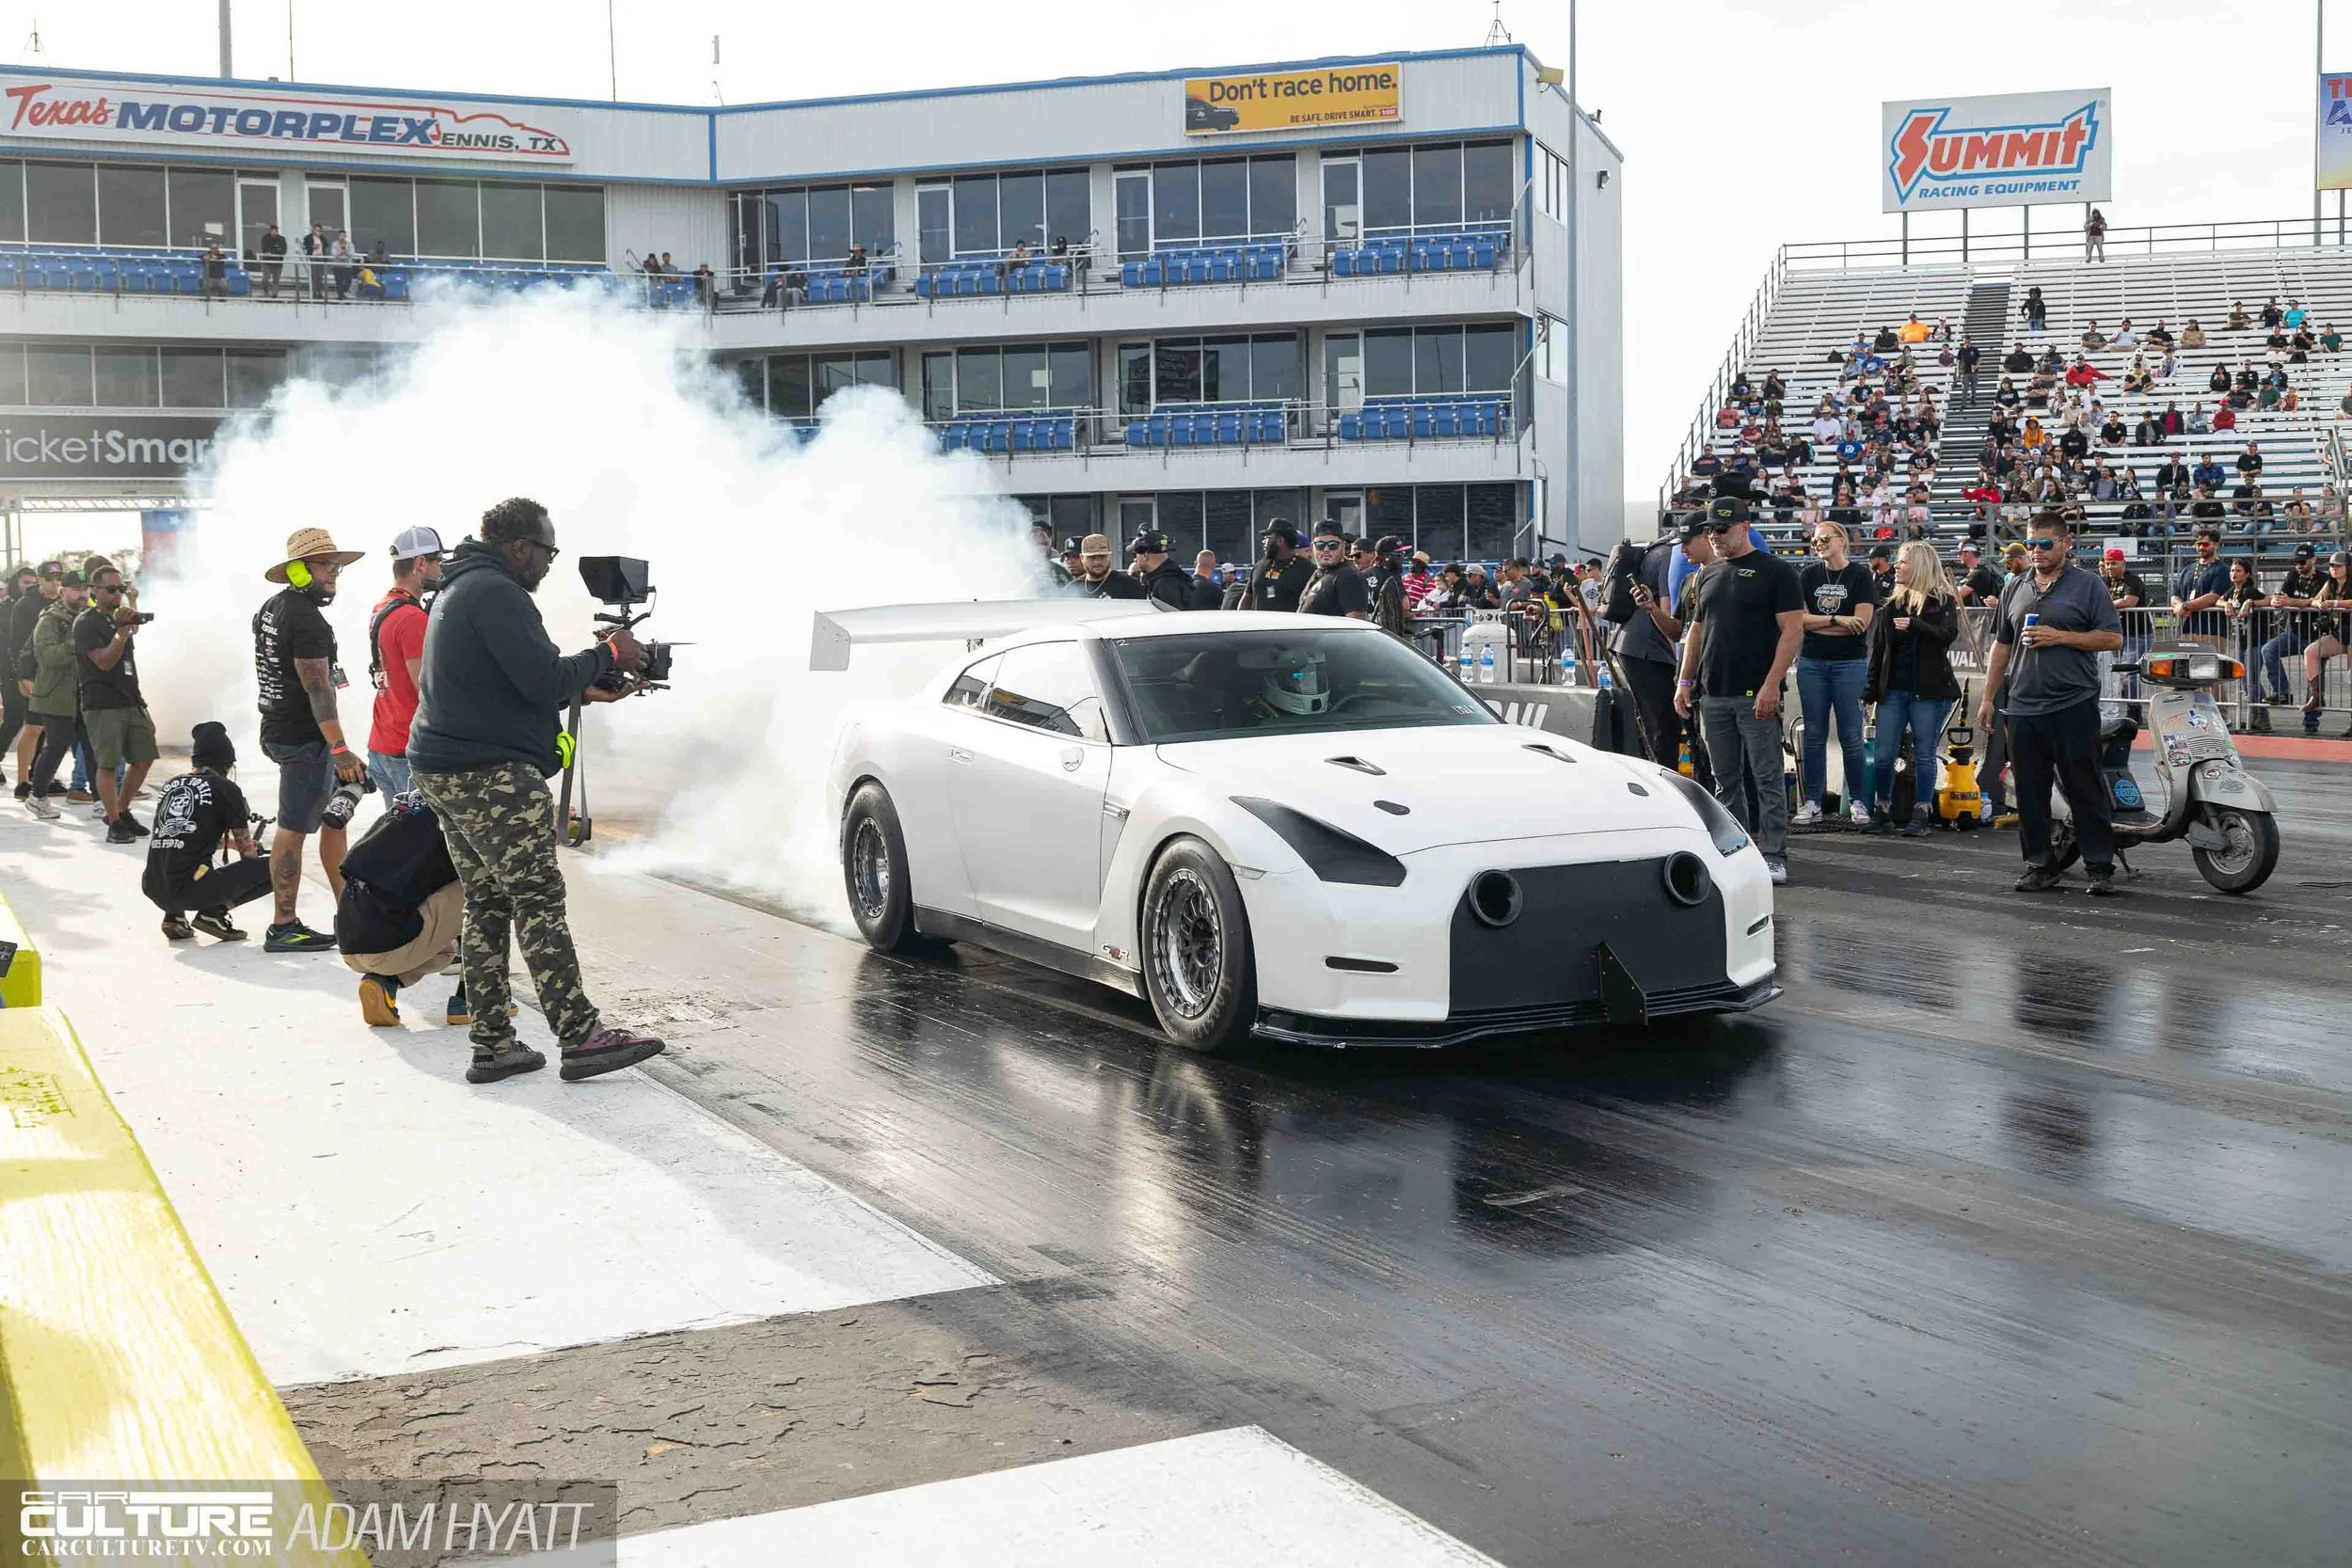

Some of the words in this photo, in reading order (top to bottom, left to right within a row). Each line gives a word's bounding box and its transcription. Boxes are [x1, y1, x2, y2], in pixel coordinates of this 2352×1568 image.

[1210, 79, 1267, 103] Don't
[1273, 78, 1323, 98] race
[1328, 72, 1397, 93] home.
[6, 85, 114, 130] Texas
[1290, 114, 1299, 123] BE
[1325, 111, 1347, 121] DRIVE
[1349, 108, 1377, 119] SMART.
[116, 102, 437, 145] MOTORPLEX
[441, 133, 519, 152] ENNIS,
[529, 136, 557, 151] TX
[1918, 185, 1979, 198] RACING
[1984, 180, 2080, 196] EQUIPMENT
